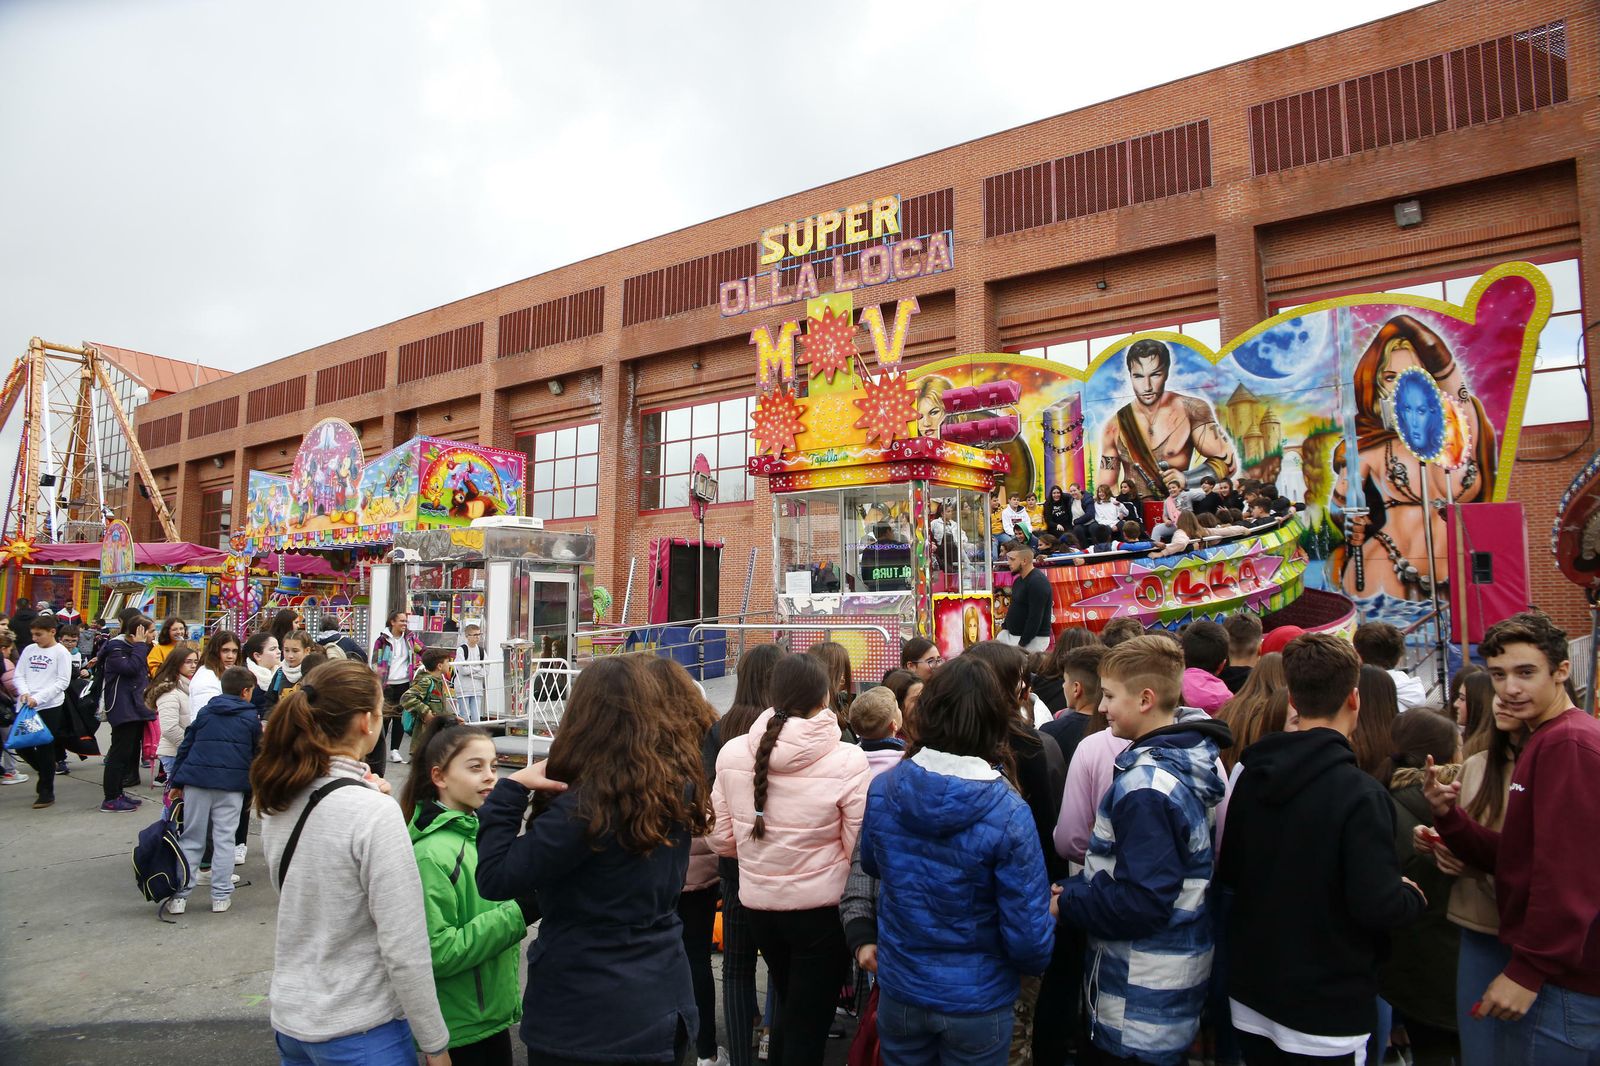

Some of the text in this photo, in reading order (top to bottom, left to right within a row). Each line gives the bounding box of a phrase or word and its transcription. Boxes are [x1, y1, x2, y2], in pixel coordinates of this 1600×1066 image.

[761, 195, 901, 265] SUPER
[719, 230, 952, 317] OLLA LOCA
[1134, 558, 1260, 609] OLLA
